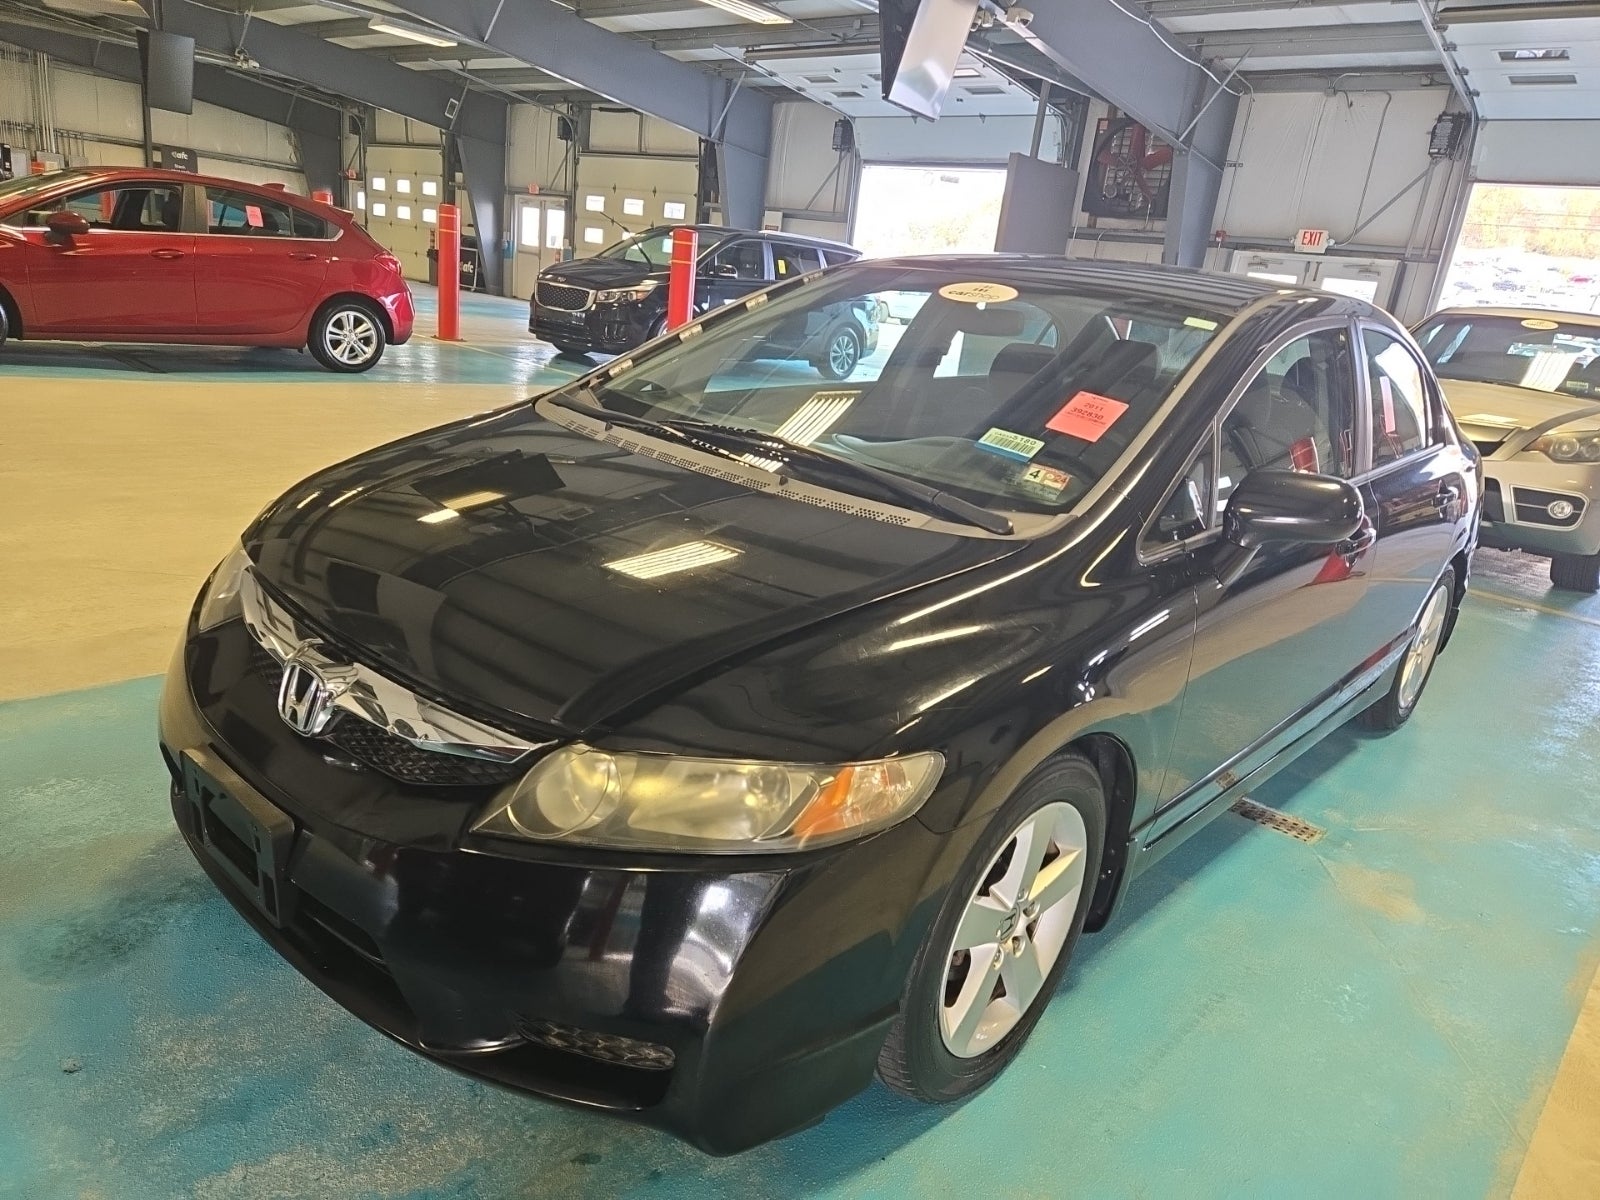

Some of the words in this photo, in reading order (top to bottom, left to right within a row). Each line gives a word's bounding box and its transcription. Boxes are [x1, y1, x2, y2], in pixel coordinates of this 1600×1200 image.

[176, 151, 189, 160] afc
[1301, 231, 1323, 246] EXIT
[1083, 402, 1104, 412] 2011
[1071, 407, 1104, 421] 392830
[1029, 469, 1041, 479] 4
